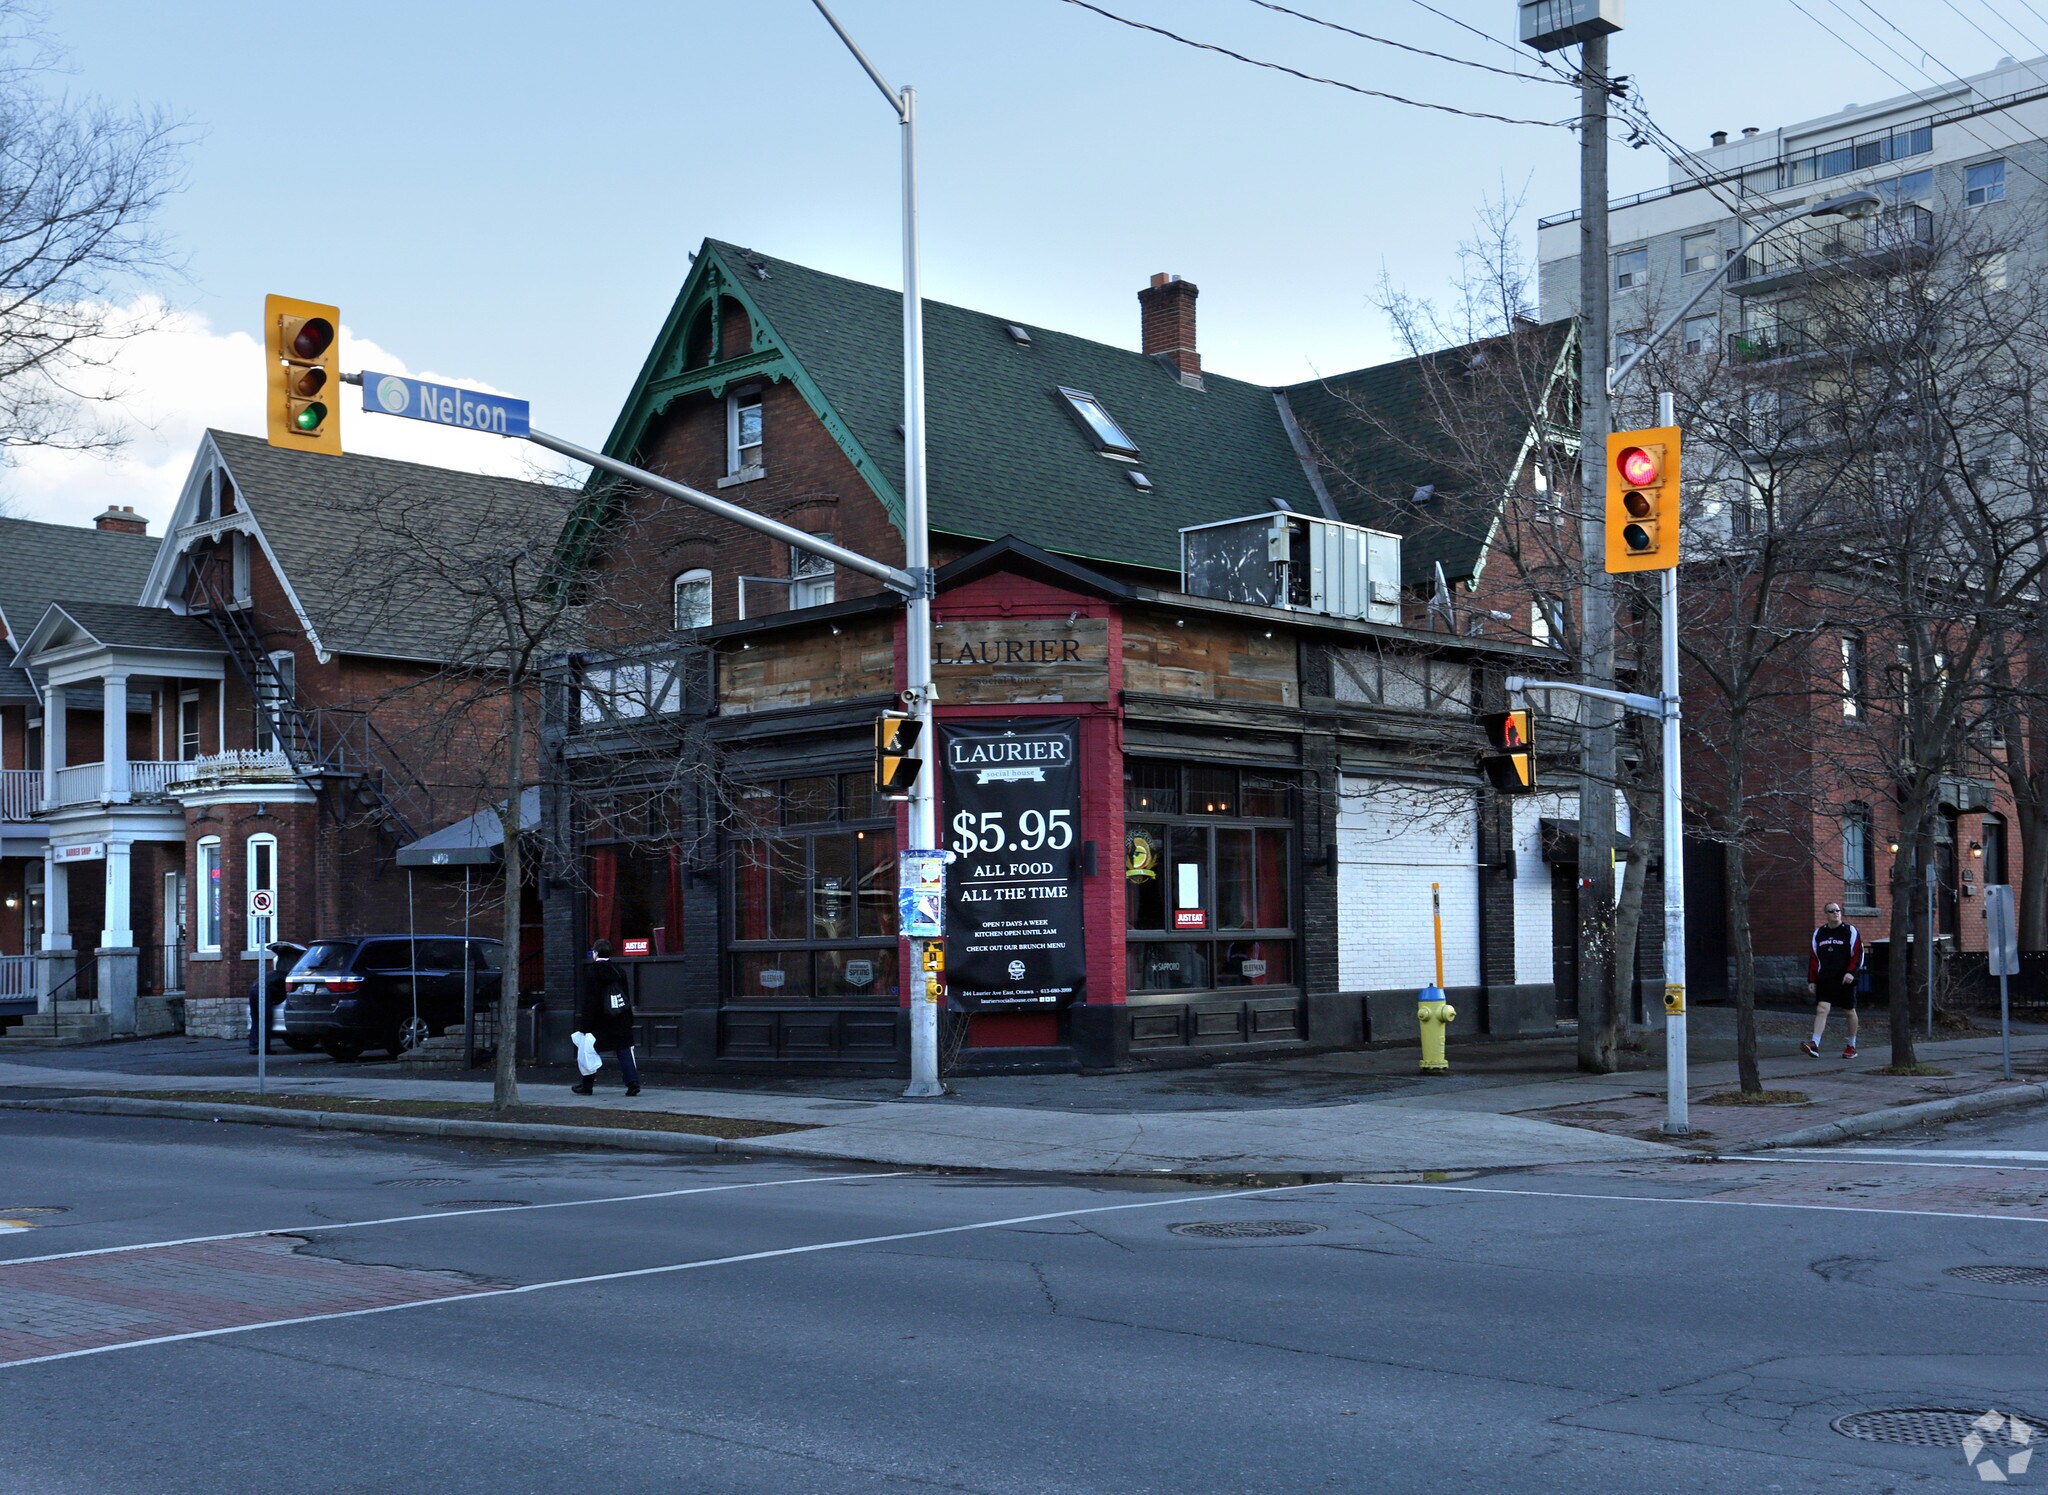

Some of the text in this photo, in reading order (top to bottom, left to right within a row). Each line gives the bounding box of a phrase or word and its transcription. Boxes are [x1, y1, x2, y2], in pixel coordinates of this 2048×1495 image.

[419, 385, 508, 433] Nelson
[935, 639, 1082, 665] LAURIER
[976, 676, 1041, 686] social house
[954, 741, 1066, 763] LAURIER
[986, 769, 1035, 777] social house
[952, 809, 1073, 859] $5.95
[973, 862, 1054, 877] ALL FOOD
[960, 886, 1068, 902] ALL THE TIME
[1177, 913, 1203, 922] JUST EAT
[637, 941, 647, 949] EAT
[1002, 988, 1015, 996] East,
